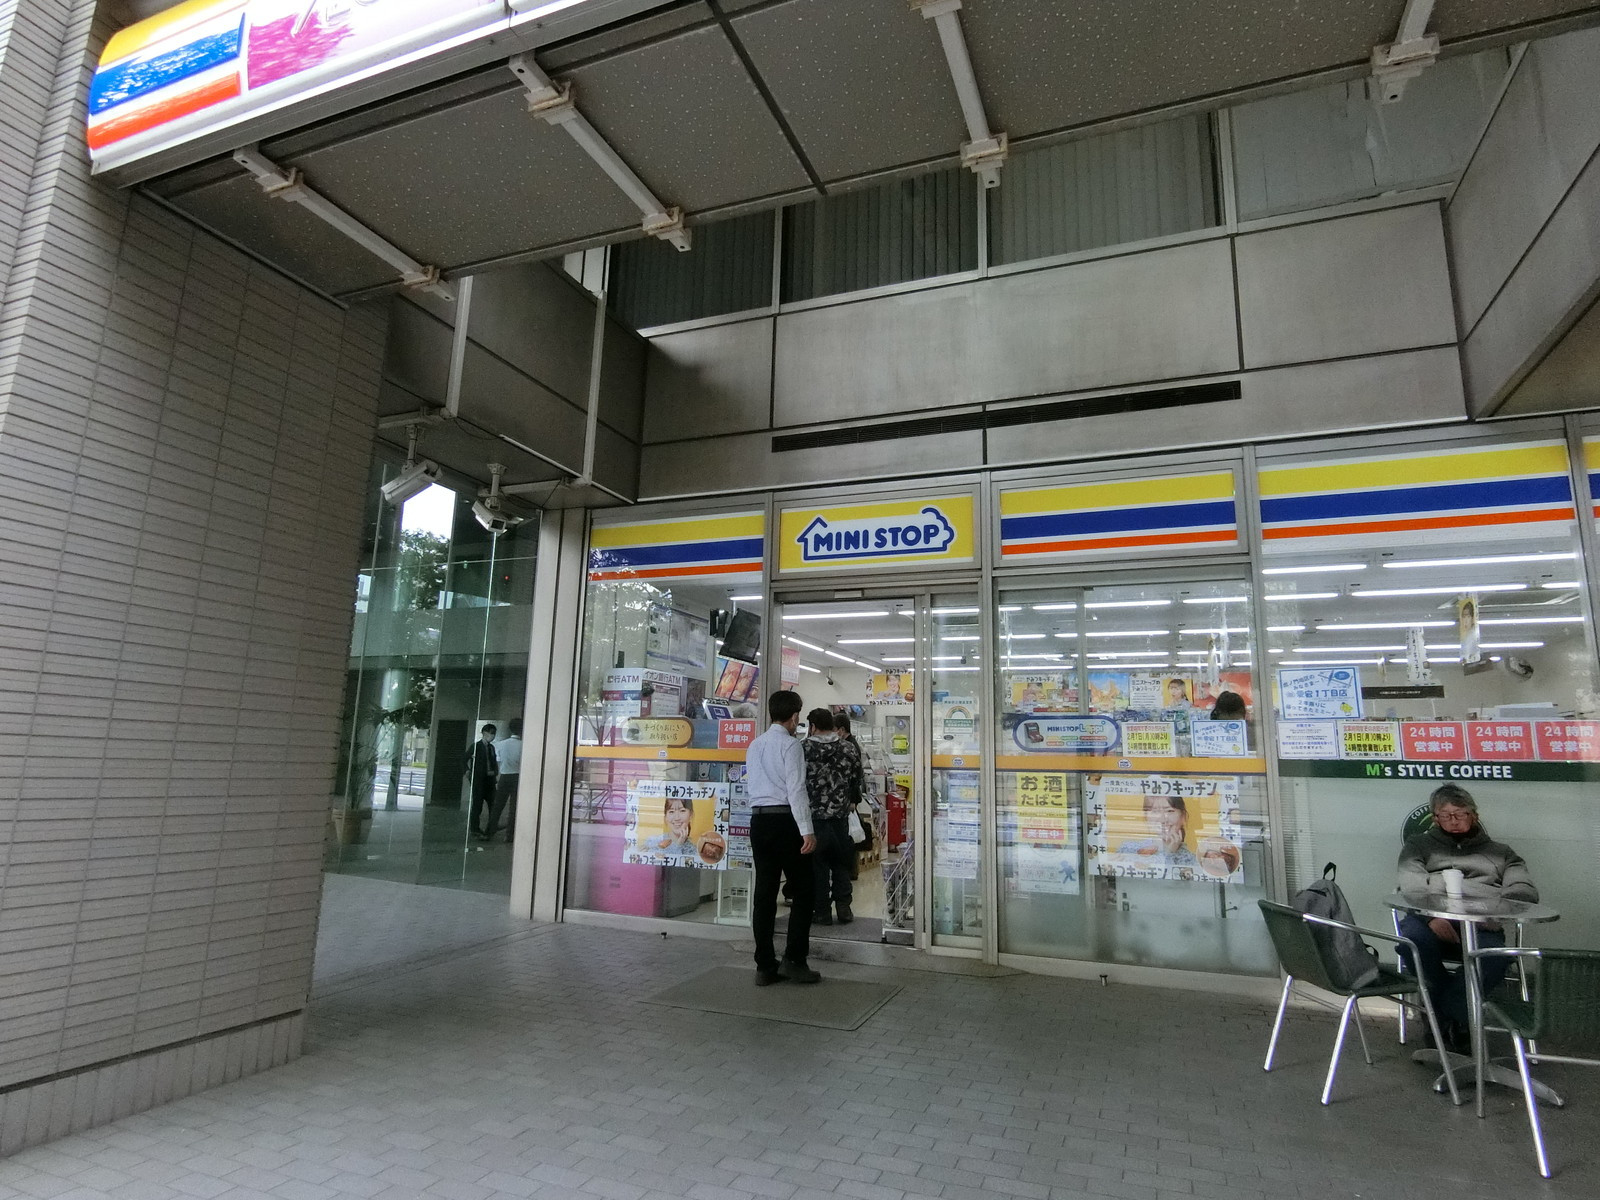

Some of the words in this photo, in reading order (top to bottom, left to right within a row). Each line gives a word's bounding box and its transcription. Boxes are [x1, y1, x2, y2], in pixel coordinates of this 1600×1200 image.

[814, 529, 869, 552] MINI
[874, 524, 940, 549] STOP
[736, 724, 752, 732] 時間
[1409, 727, 1426, 737] 24
[1429, 727, 1456, 738] 時間
[1476, 726, 1492, 737] 24
[1495, 726, 1523, 737] 時間
[1544, 726, 1562, 737] 24
[1565, 726, 1594, 737] 時間
[725, 734, 749, 743] 営業中
[1414, 741, 1453, 752] 営業中
[1480, 741, 1521, 752] 営業中
[1549, 741, 1592, 752] 営業中
[1366, 763, 1392, 777] M's
[1397, 764, 1443, 777] STYLE
[1449, 765, 1513, 779] COFFEE
[1020, 775, 1062, 793] お酒
[1140, 780, 1218, 796] やみつキッチン
[665, 785, 716, 798] やみつキッチン
[1021, 793, 1063, 806] たばこ
